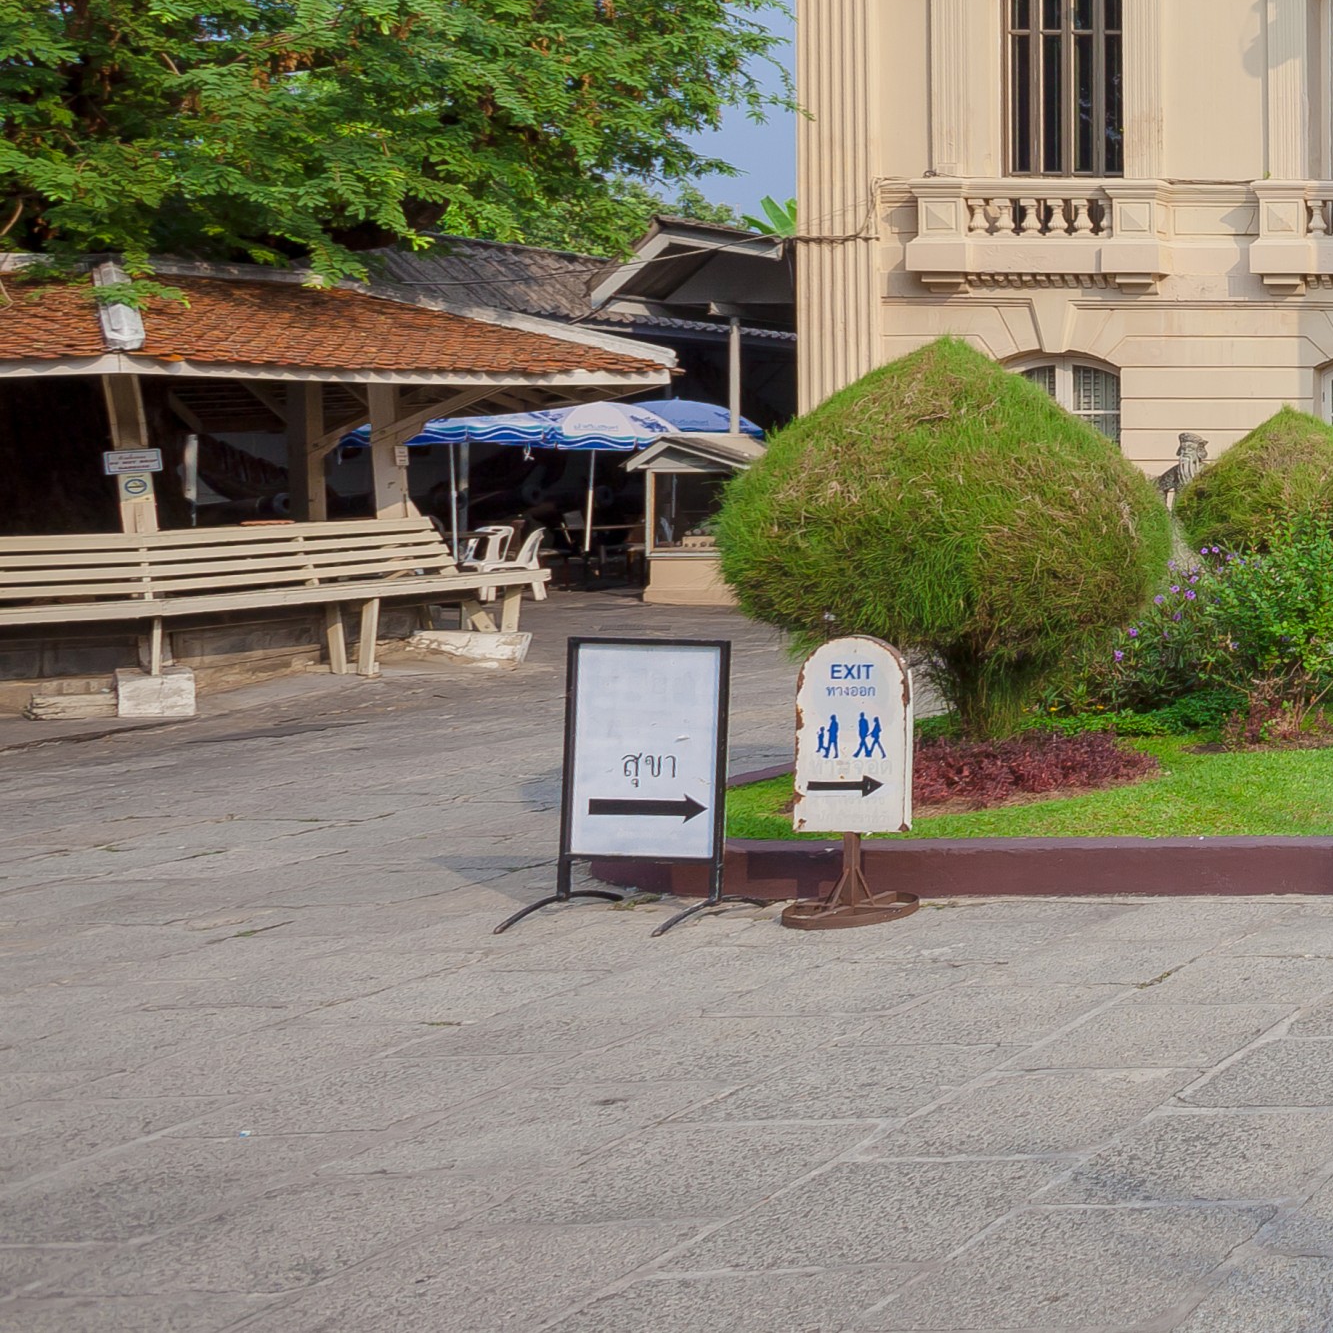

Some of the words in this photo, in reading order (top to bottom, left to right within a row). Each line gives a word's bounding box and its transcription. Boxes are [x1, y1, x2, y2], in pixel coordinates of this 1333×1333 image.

[830, 664, 874, 680] EXIT
[826, 685, 876, 697] ทางออก
[621, 753, 677, 788] สุขา
